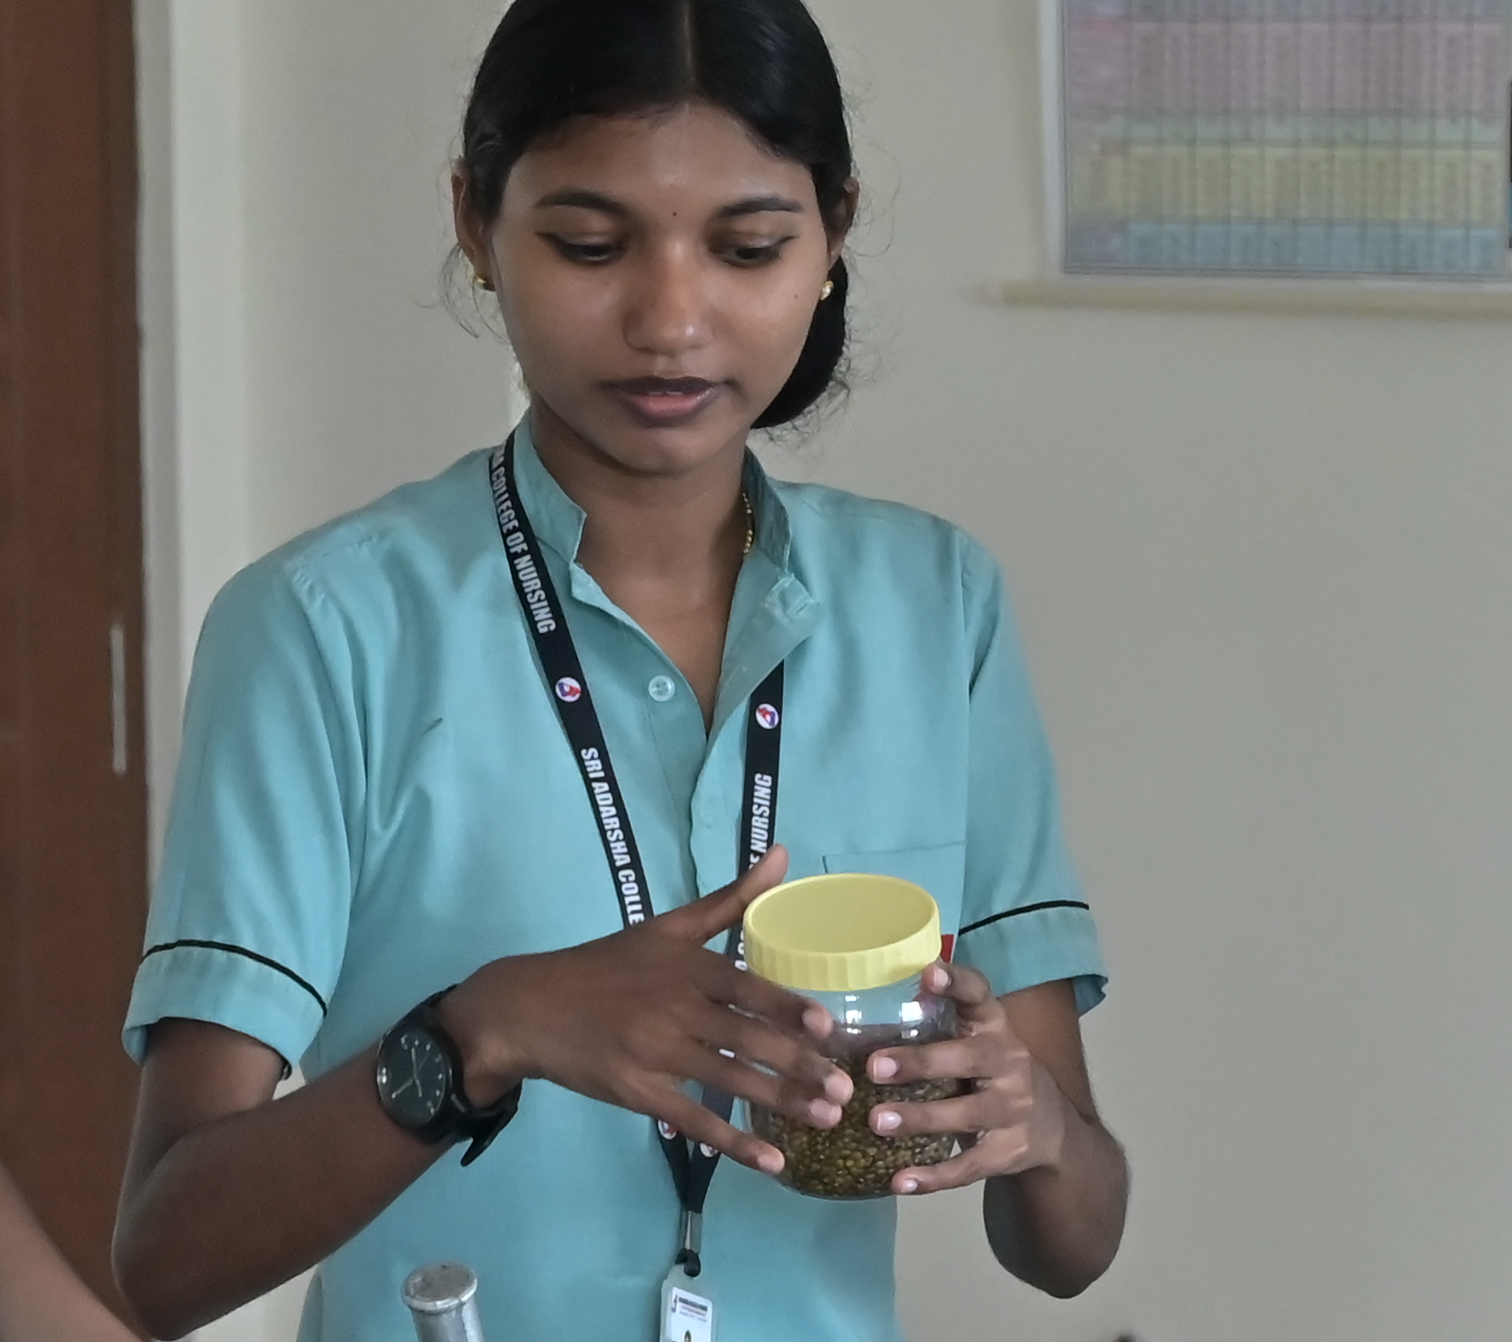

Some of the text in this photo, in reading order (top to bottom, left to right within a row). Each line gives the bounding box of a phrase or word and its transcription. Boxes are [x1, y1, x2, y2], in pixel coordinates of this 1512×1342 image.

[491, 466, 520, 534] COLLEGE
[506, 531, 529, 554] OF
[514, 554, 557, 635] NURSING
[581, 746, 645, 927] SRI ADARSHA COLLE
[750, 772, 774, 854] NURSING
